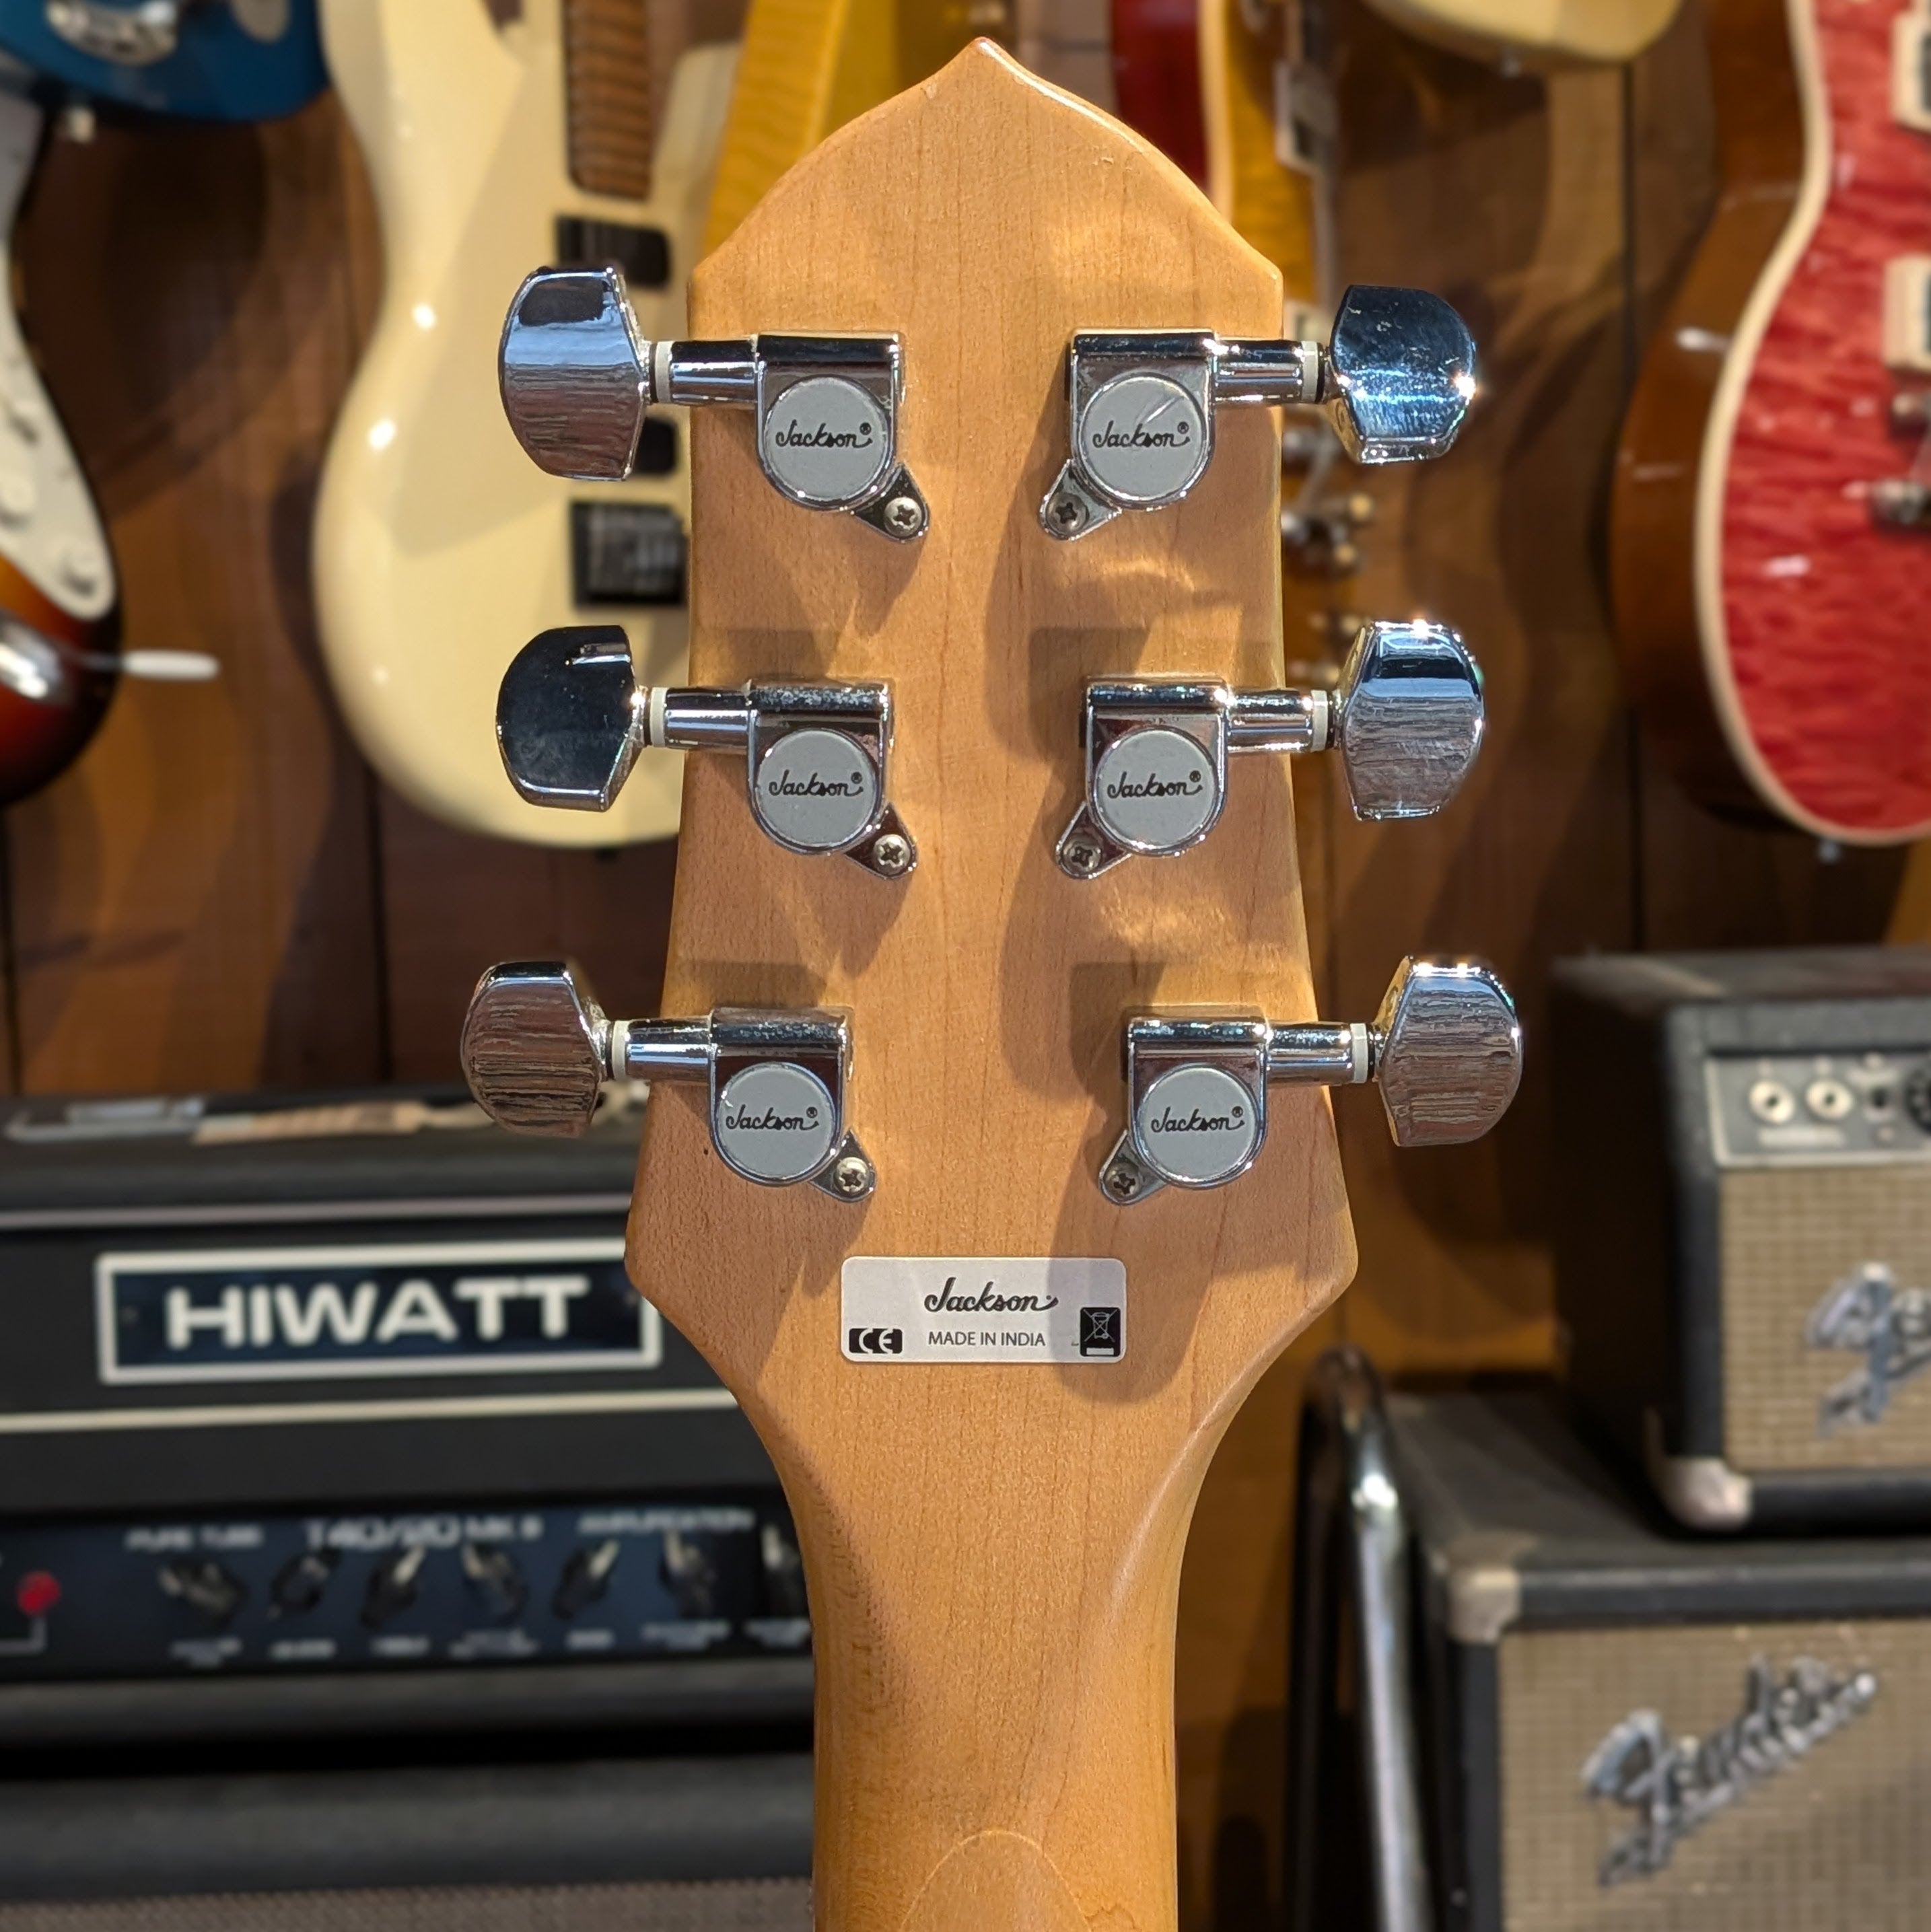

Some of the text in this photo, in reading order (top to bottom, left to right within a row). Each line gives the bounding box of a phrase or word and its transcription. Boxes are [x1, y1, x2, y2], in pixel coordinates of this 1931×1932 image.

[166, 1276, 590, 1347] HIWATT
[924, 1277, 1059, 1312] Jackson
[928, 1331, 1046, 1346] MADE IN INDIA
